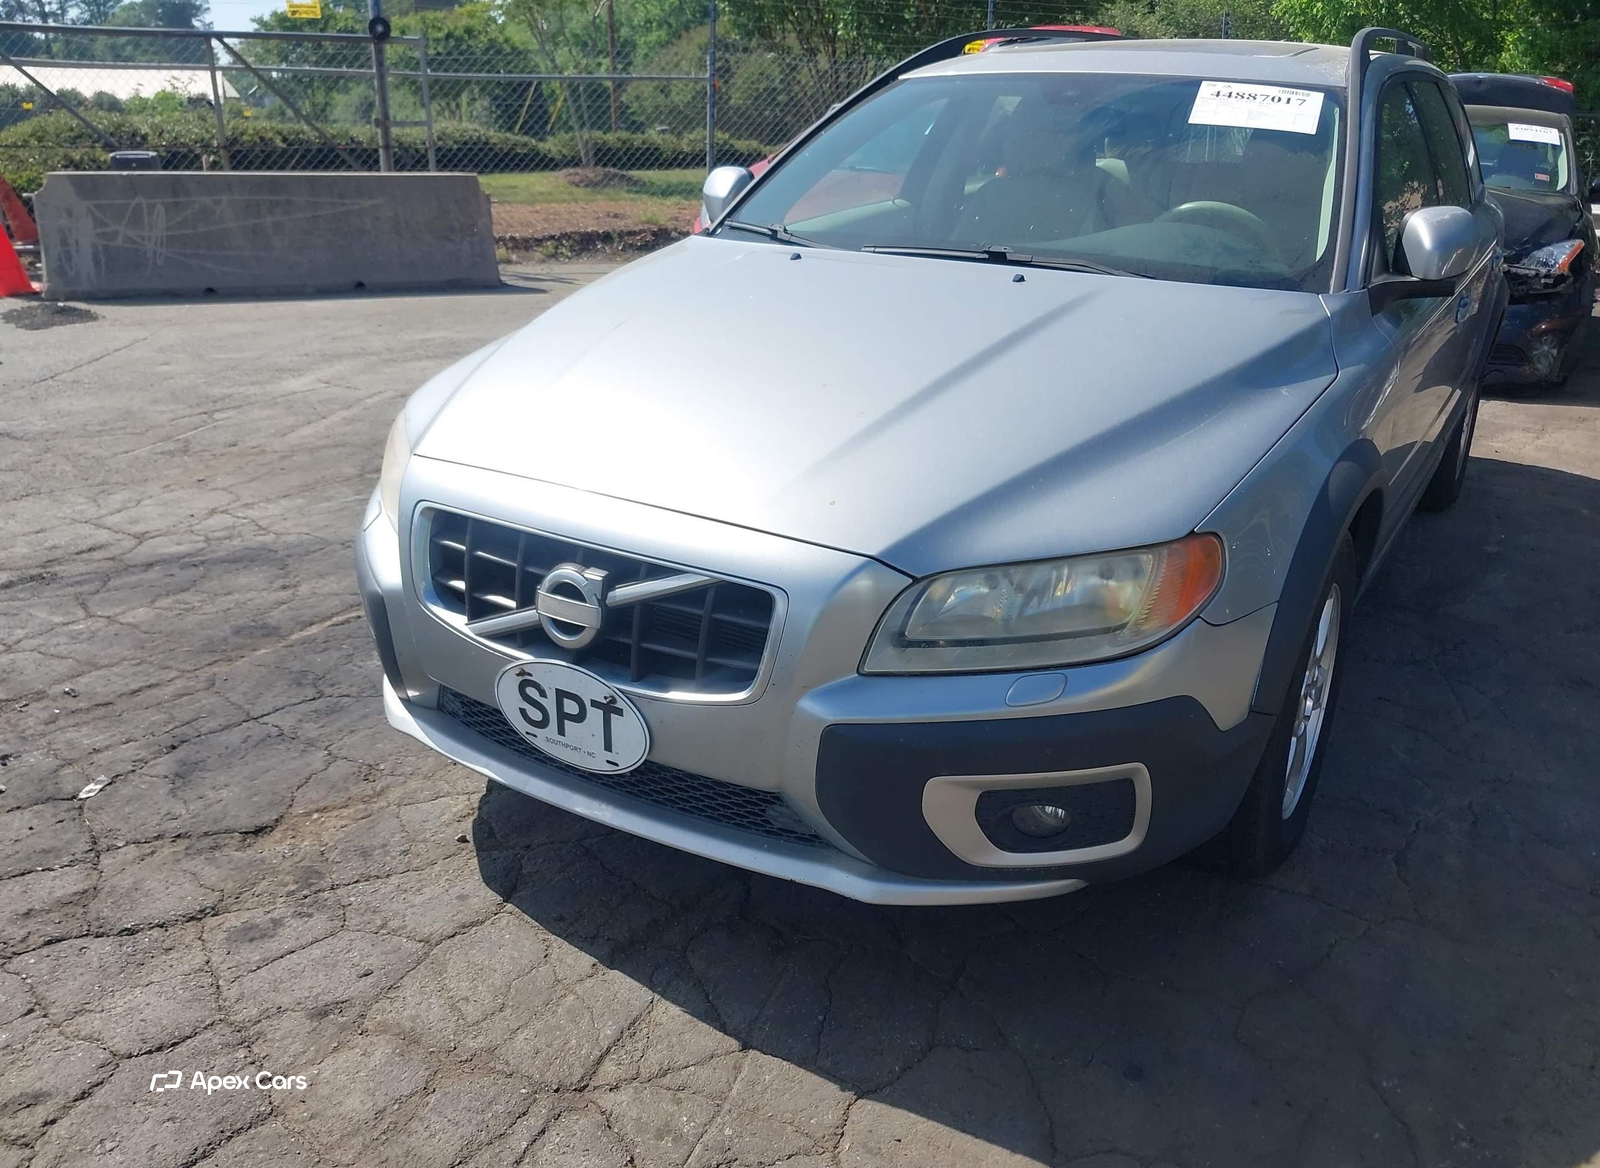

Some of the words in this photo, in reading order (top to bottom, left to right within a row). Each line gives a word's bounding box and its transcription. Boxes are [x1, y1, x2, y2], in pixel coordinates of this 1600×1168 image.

[1210, 89, 1307, 107] 44887017
[517, 678, 624, 753] SPT
[545, 736, 582, 754] SOUTHPORT
[586, 750, 597, 759] NC
